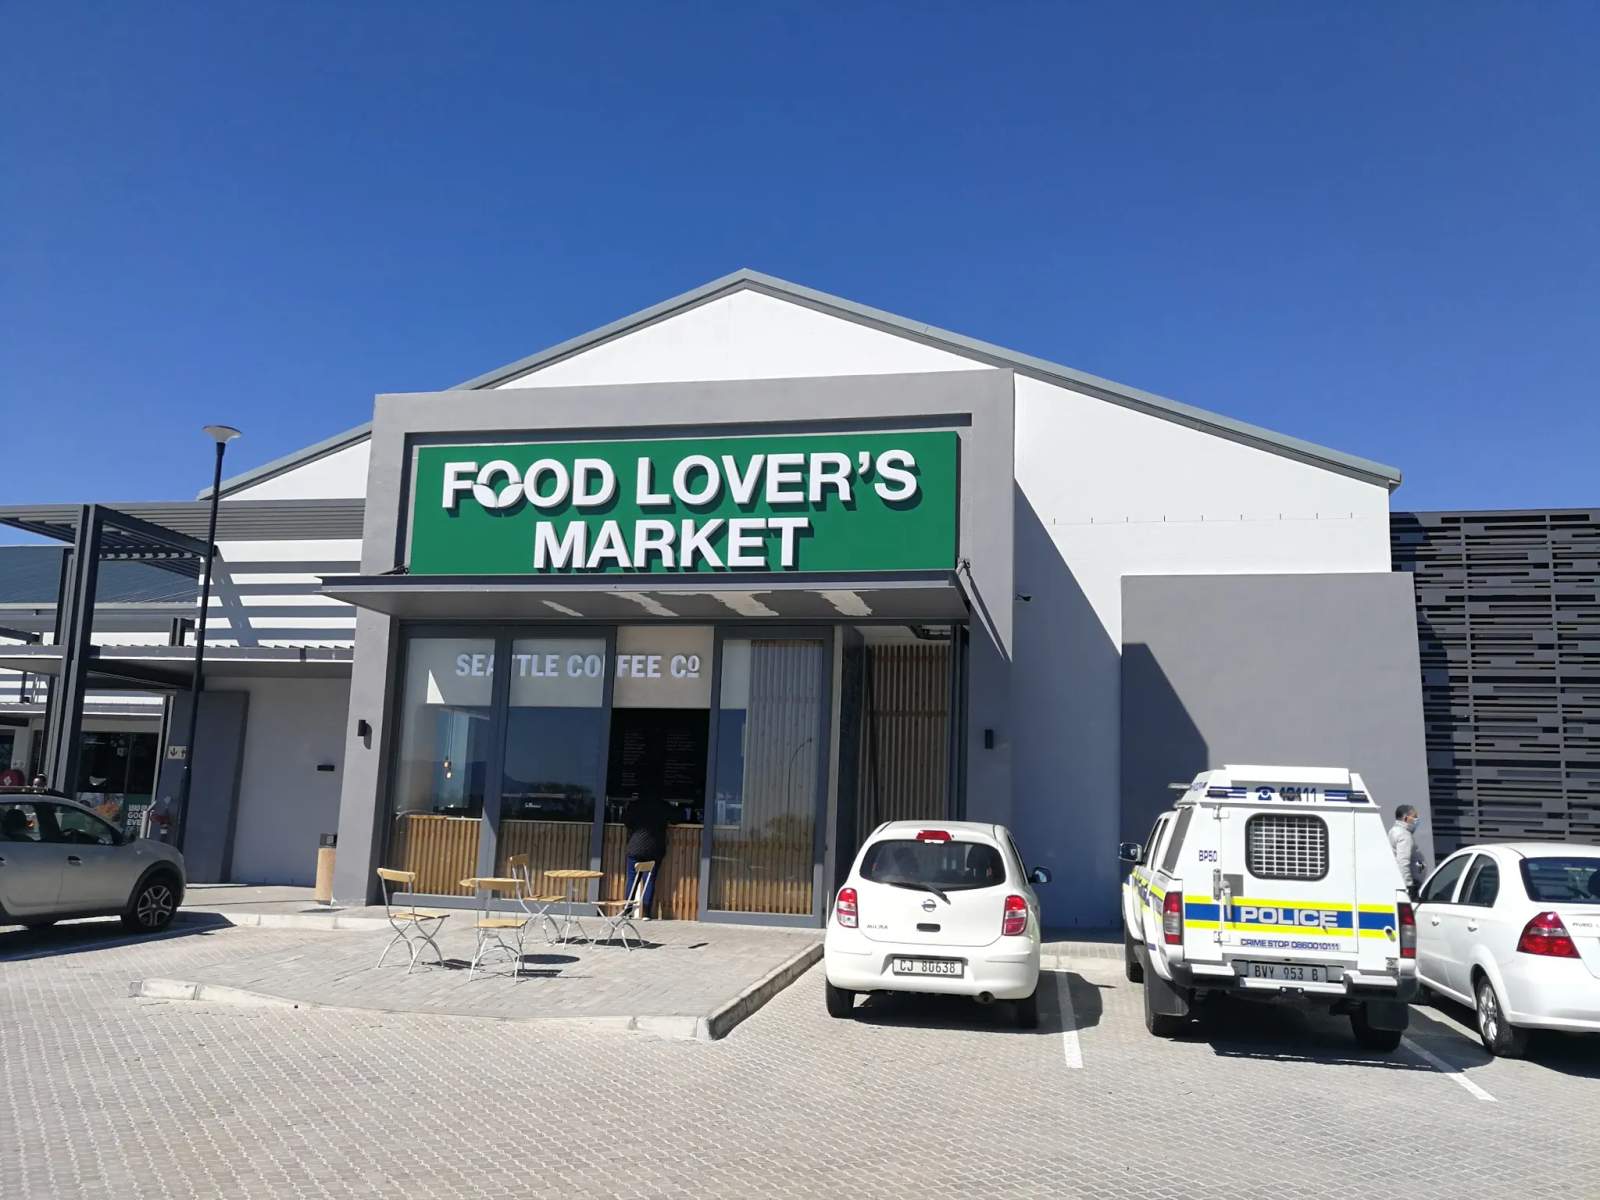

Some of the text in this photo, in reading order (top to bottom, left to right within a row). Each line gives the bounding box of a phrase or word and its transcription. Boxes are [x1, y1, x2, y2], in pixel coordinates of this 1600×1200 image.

[442, 449, 918, 509] FOOD LOVER'S
[533, 517, 809, 569] MARKET
[456, 654, 560, 677] SEATLE
[567, 655, 662, 678] COFEE
[1240, 906, 1338, 928] POLICE
[1240, 938, 1267, 948] CRIME
[1268, 940, 1290, 949] STOP
[899, 959, 956, 974] CJ 80638
[1254, 964, 1319, 981] BVY 953 B
